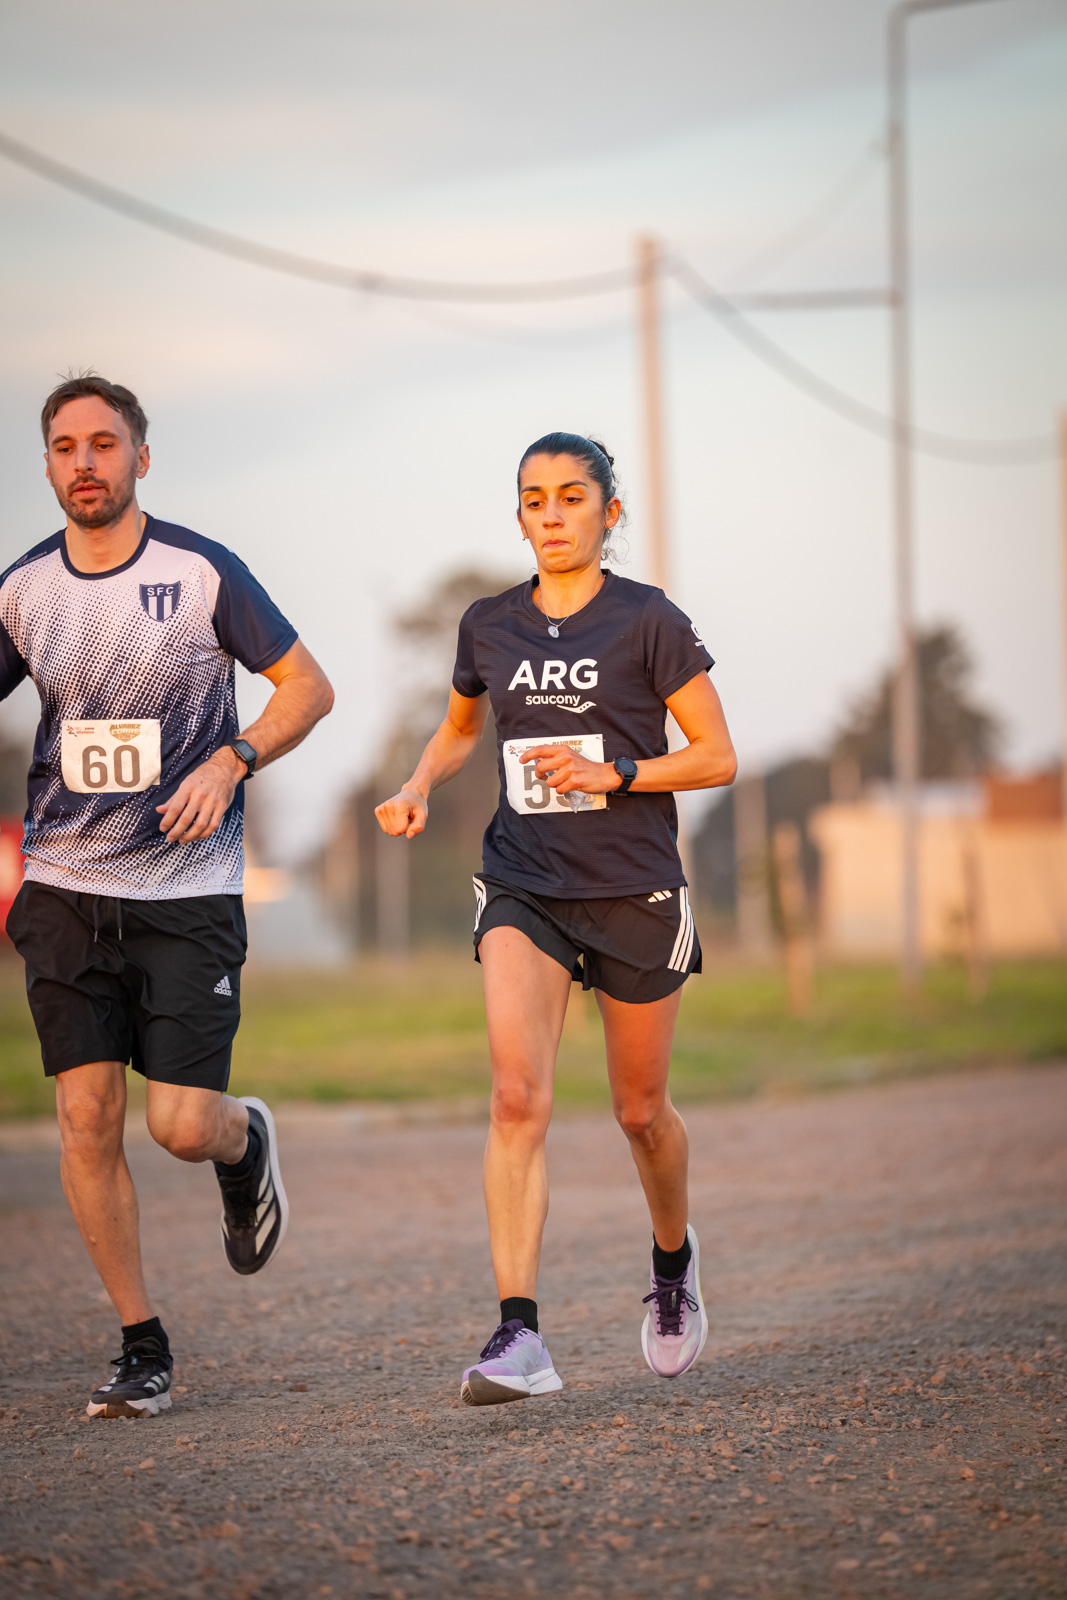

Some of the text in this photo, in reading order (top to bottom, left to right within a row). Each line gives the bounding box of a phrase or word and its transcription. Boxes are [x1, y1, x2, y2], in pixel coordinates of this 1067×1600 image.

[147, 586, 174, 596] SFC
[507, 658, 599, 691] ARG
[525, 695, 581, 707] saucony
[82, 745, 140, 788] 60
[523, 765, 571, 809] 5
[214, 986, 232, 996] adidas
